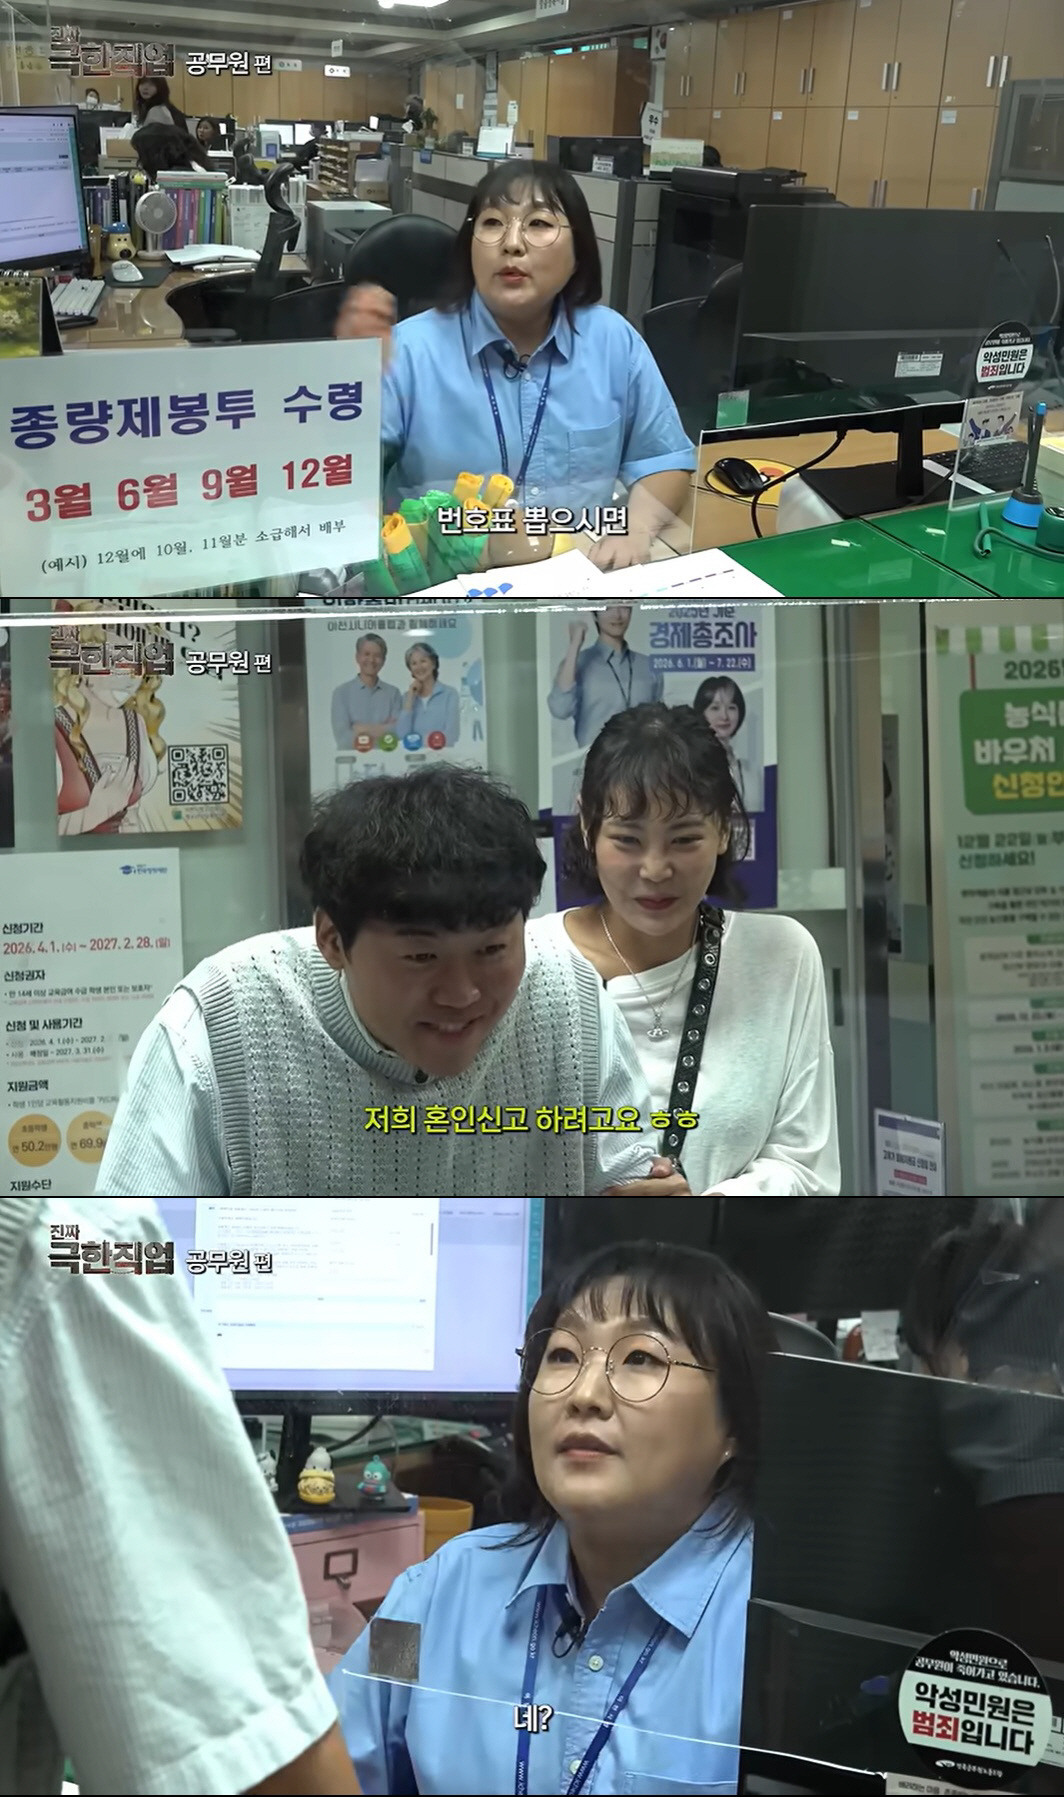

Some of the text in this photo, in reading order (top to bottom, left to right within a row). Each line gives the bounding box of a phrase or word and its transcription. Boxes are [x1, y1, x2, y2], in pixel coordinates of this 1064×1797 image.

[981, 362, 1025, 378] 범죄입니다
[983, 349, 1028, 364] 악성민원은
[10, 381, 364, 450] 종량제봉투 수령
[26, 454, 354, 523] 3월 6월 9월 12월
[41, 555, 88, 574] (예시)
[97, 545, 148, 566] 12월에
[202, 532, 247, 551] 11월분
[256, 524, 312, 545] 소급해서
[319, 519, 346, 536] 배부
[649, 621, 757, 649] 경제총조사
[1004, 660, 1064, 680] 2026
[973, 735, 1056, 764] 바우처
[2, 922, 44, 935] 신청기간
[7, 1080, 49, 1092] 지원금액
[914, 1656, 1041, 1689] 공무원이 죽어가고 있습니다.
[949, 1650, 1008, 1670] 악성민원으로
[915, 1682, 1035, 1727] 악성민원은
[912, 1710, 1034, 1755] 범죄입니다
